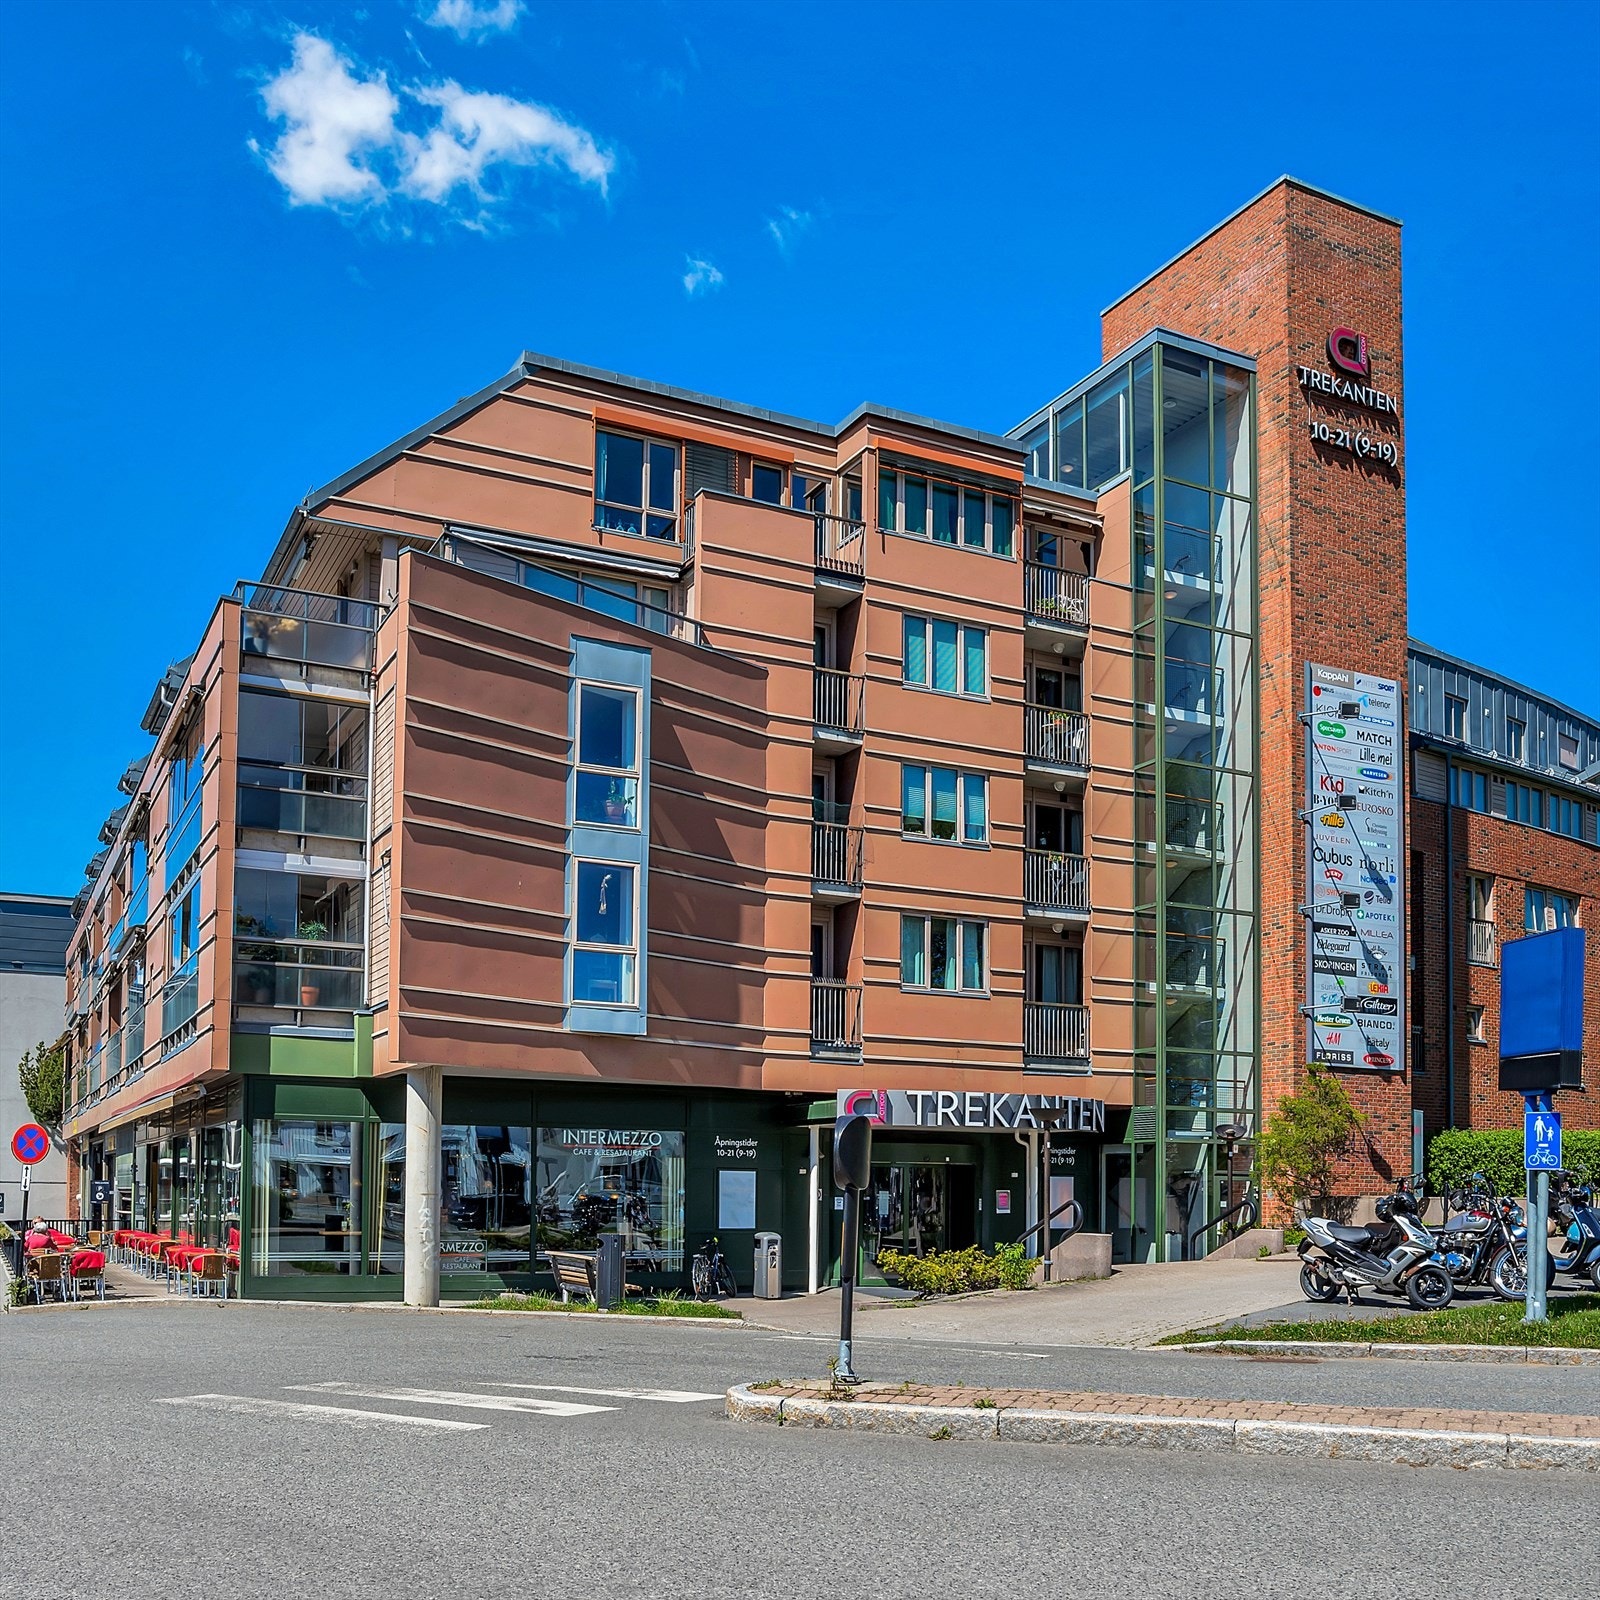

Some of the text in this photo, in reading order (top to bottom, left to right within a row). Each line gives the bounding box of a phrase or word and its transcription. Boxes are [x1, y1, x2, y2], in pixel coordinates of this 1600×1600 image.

[1300, 366, 1397, 413] TREKANTEN
[1312, 422, 1398, 467] 10-21 (9-19)
[1317, 668, 1349, 682] KappAhl
[1369, 698, 1391, 709] telenor
[1357, 731, 1392, 747] MATCH
[1360, 748, 1393, 766] Lille mei
[1321, 775, 1344, 793] Kid
[1357, 802, 1394, 817] EUROSKO
[1322, 812, 1345, 829] nille
[1315, 833, 1351, 845] JUVELEN
[1313, 846, 1353, 867] Cubus
[1360, 857, 1395, 873] norli
[1365, 912, 1391, 922] APOTEK
[1338, 928, 1350, 936] ZOO
[1361, 928, 1394, 939] MILLEA
[1363, 998, 1393, 1010] Glitter
[1316, 1051, 1352, 1062] FLORISS
[906, 1090, 1105, 1132] TREKANTEN
[562, 1129, 662, 1147] INTERMEZZO
[714, 1135, 758, 1148] Åpningstider
[717, 1148, 757, 1159] 10-21 (9-19)
[1040, 1144, 1076, 1156] Åningstider
[1057, 1156, 1075, 1166] (9-19)
